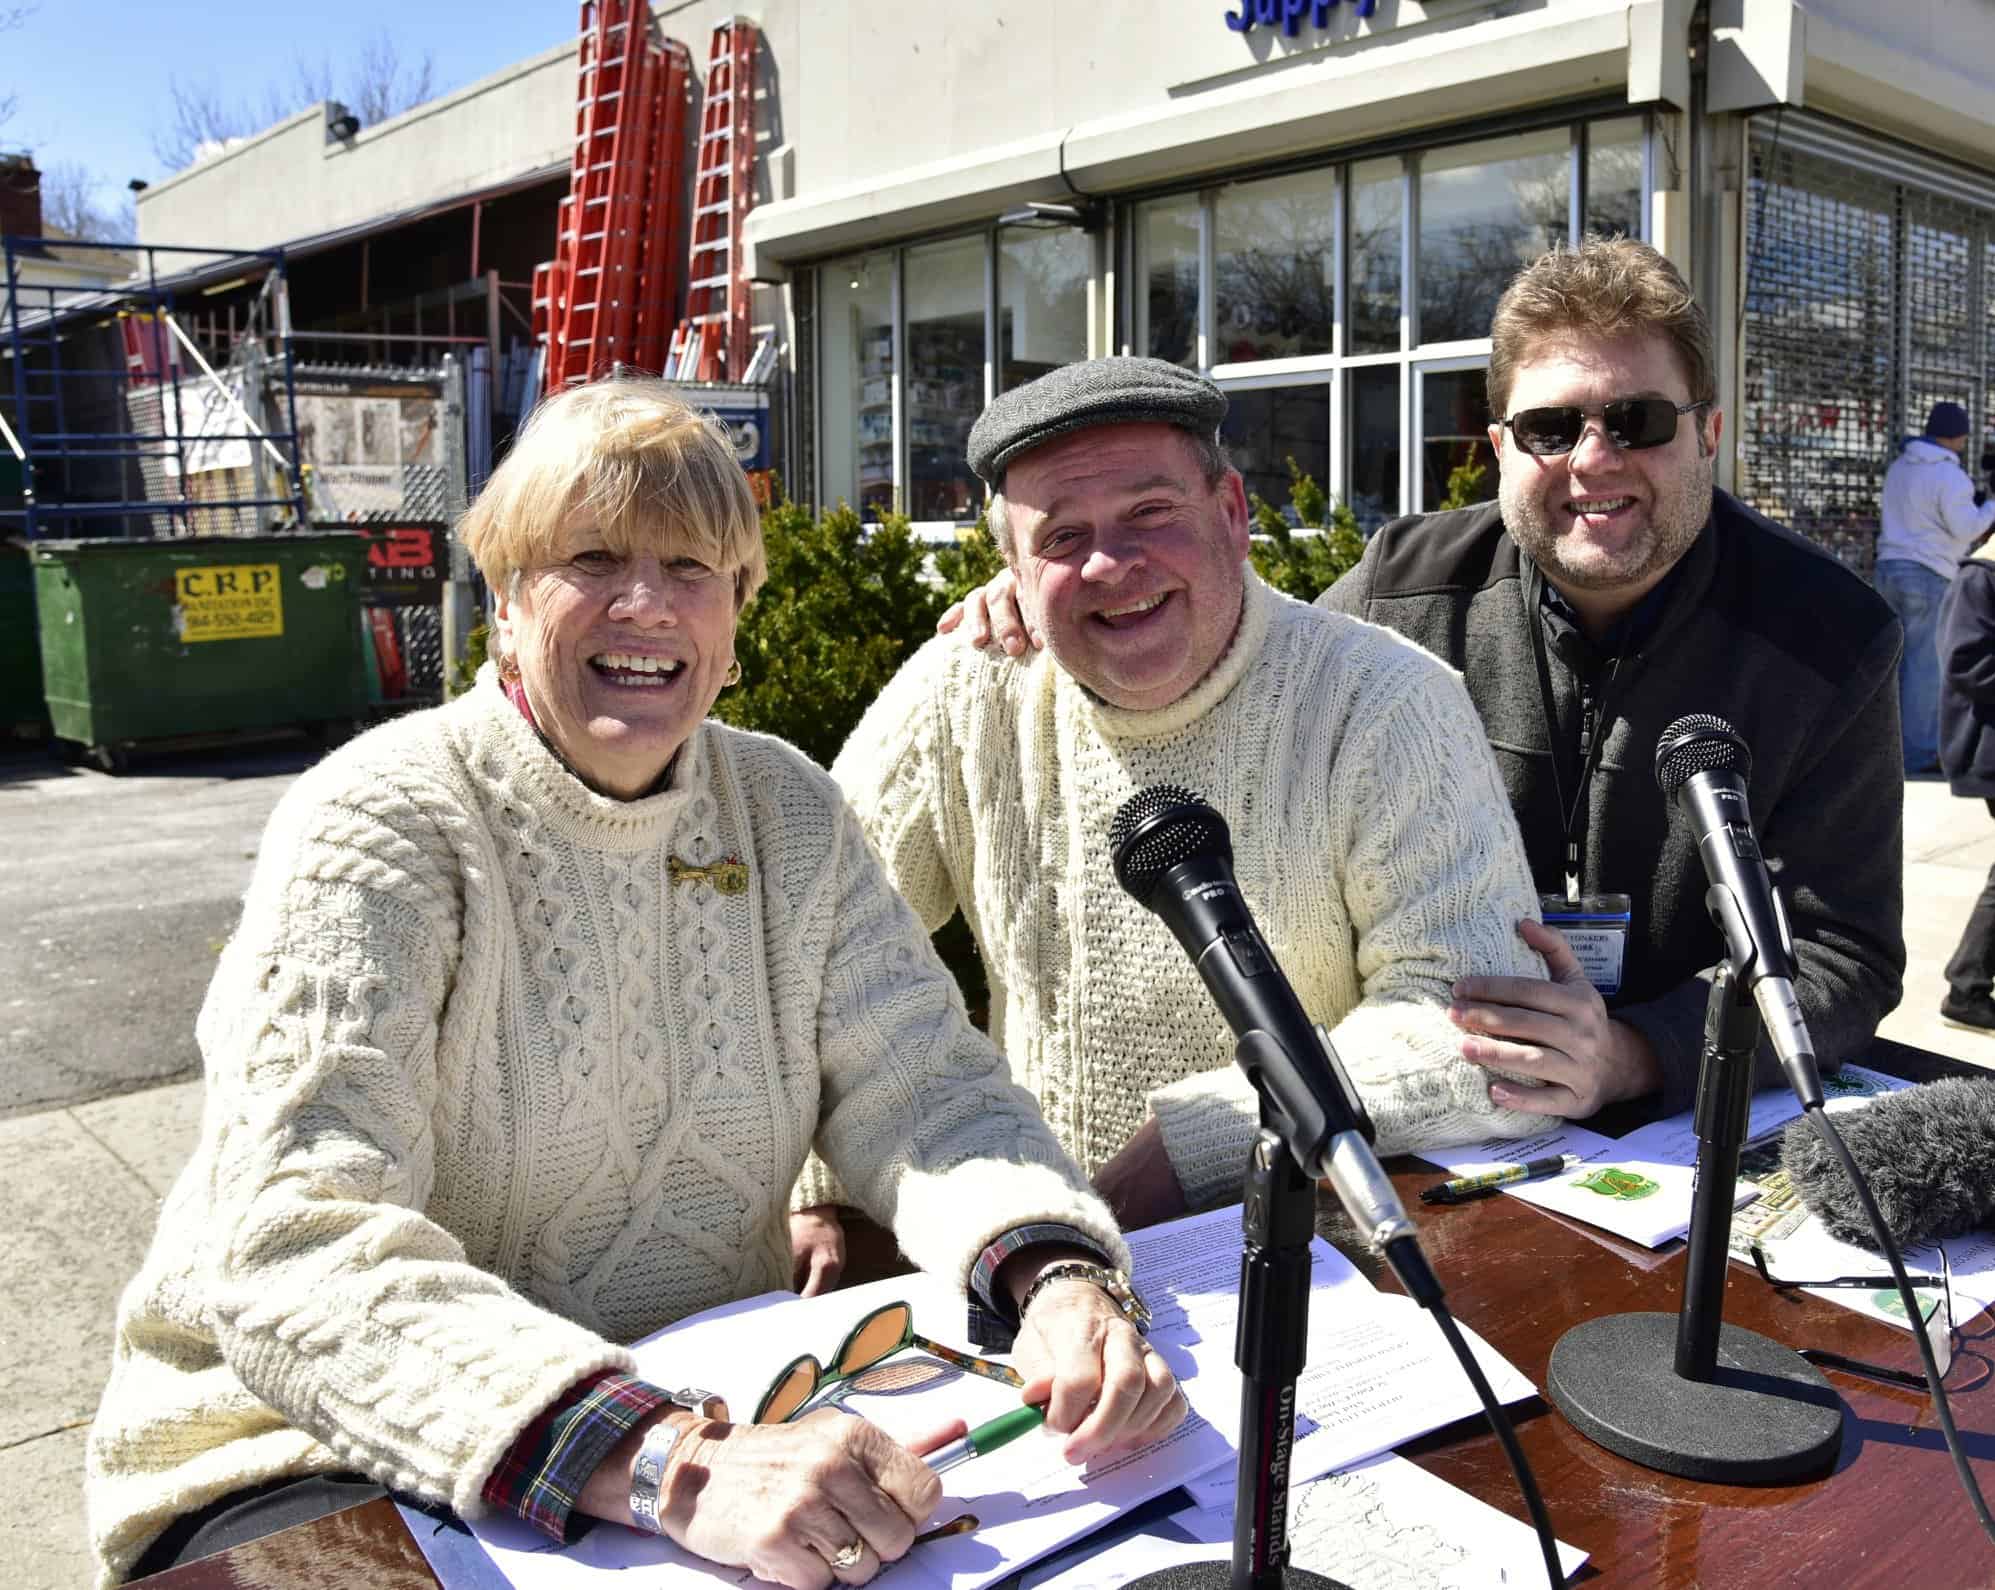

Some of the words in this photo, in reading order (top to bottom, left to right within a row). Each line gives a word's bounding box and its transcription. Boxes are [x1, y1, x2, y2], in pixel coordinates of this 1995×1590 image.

[183, 571, 273, 597] C.R.P.
[1270, 1385, 1293, 1486] On-Stage
[1268, 1495, 1288, 1566] Stands
